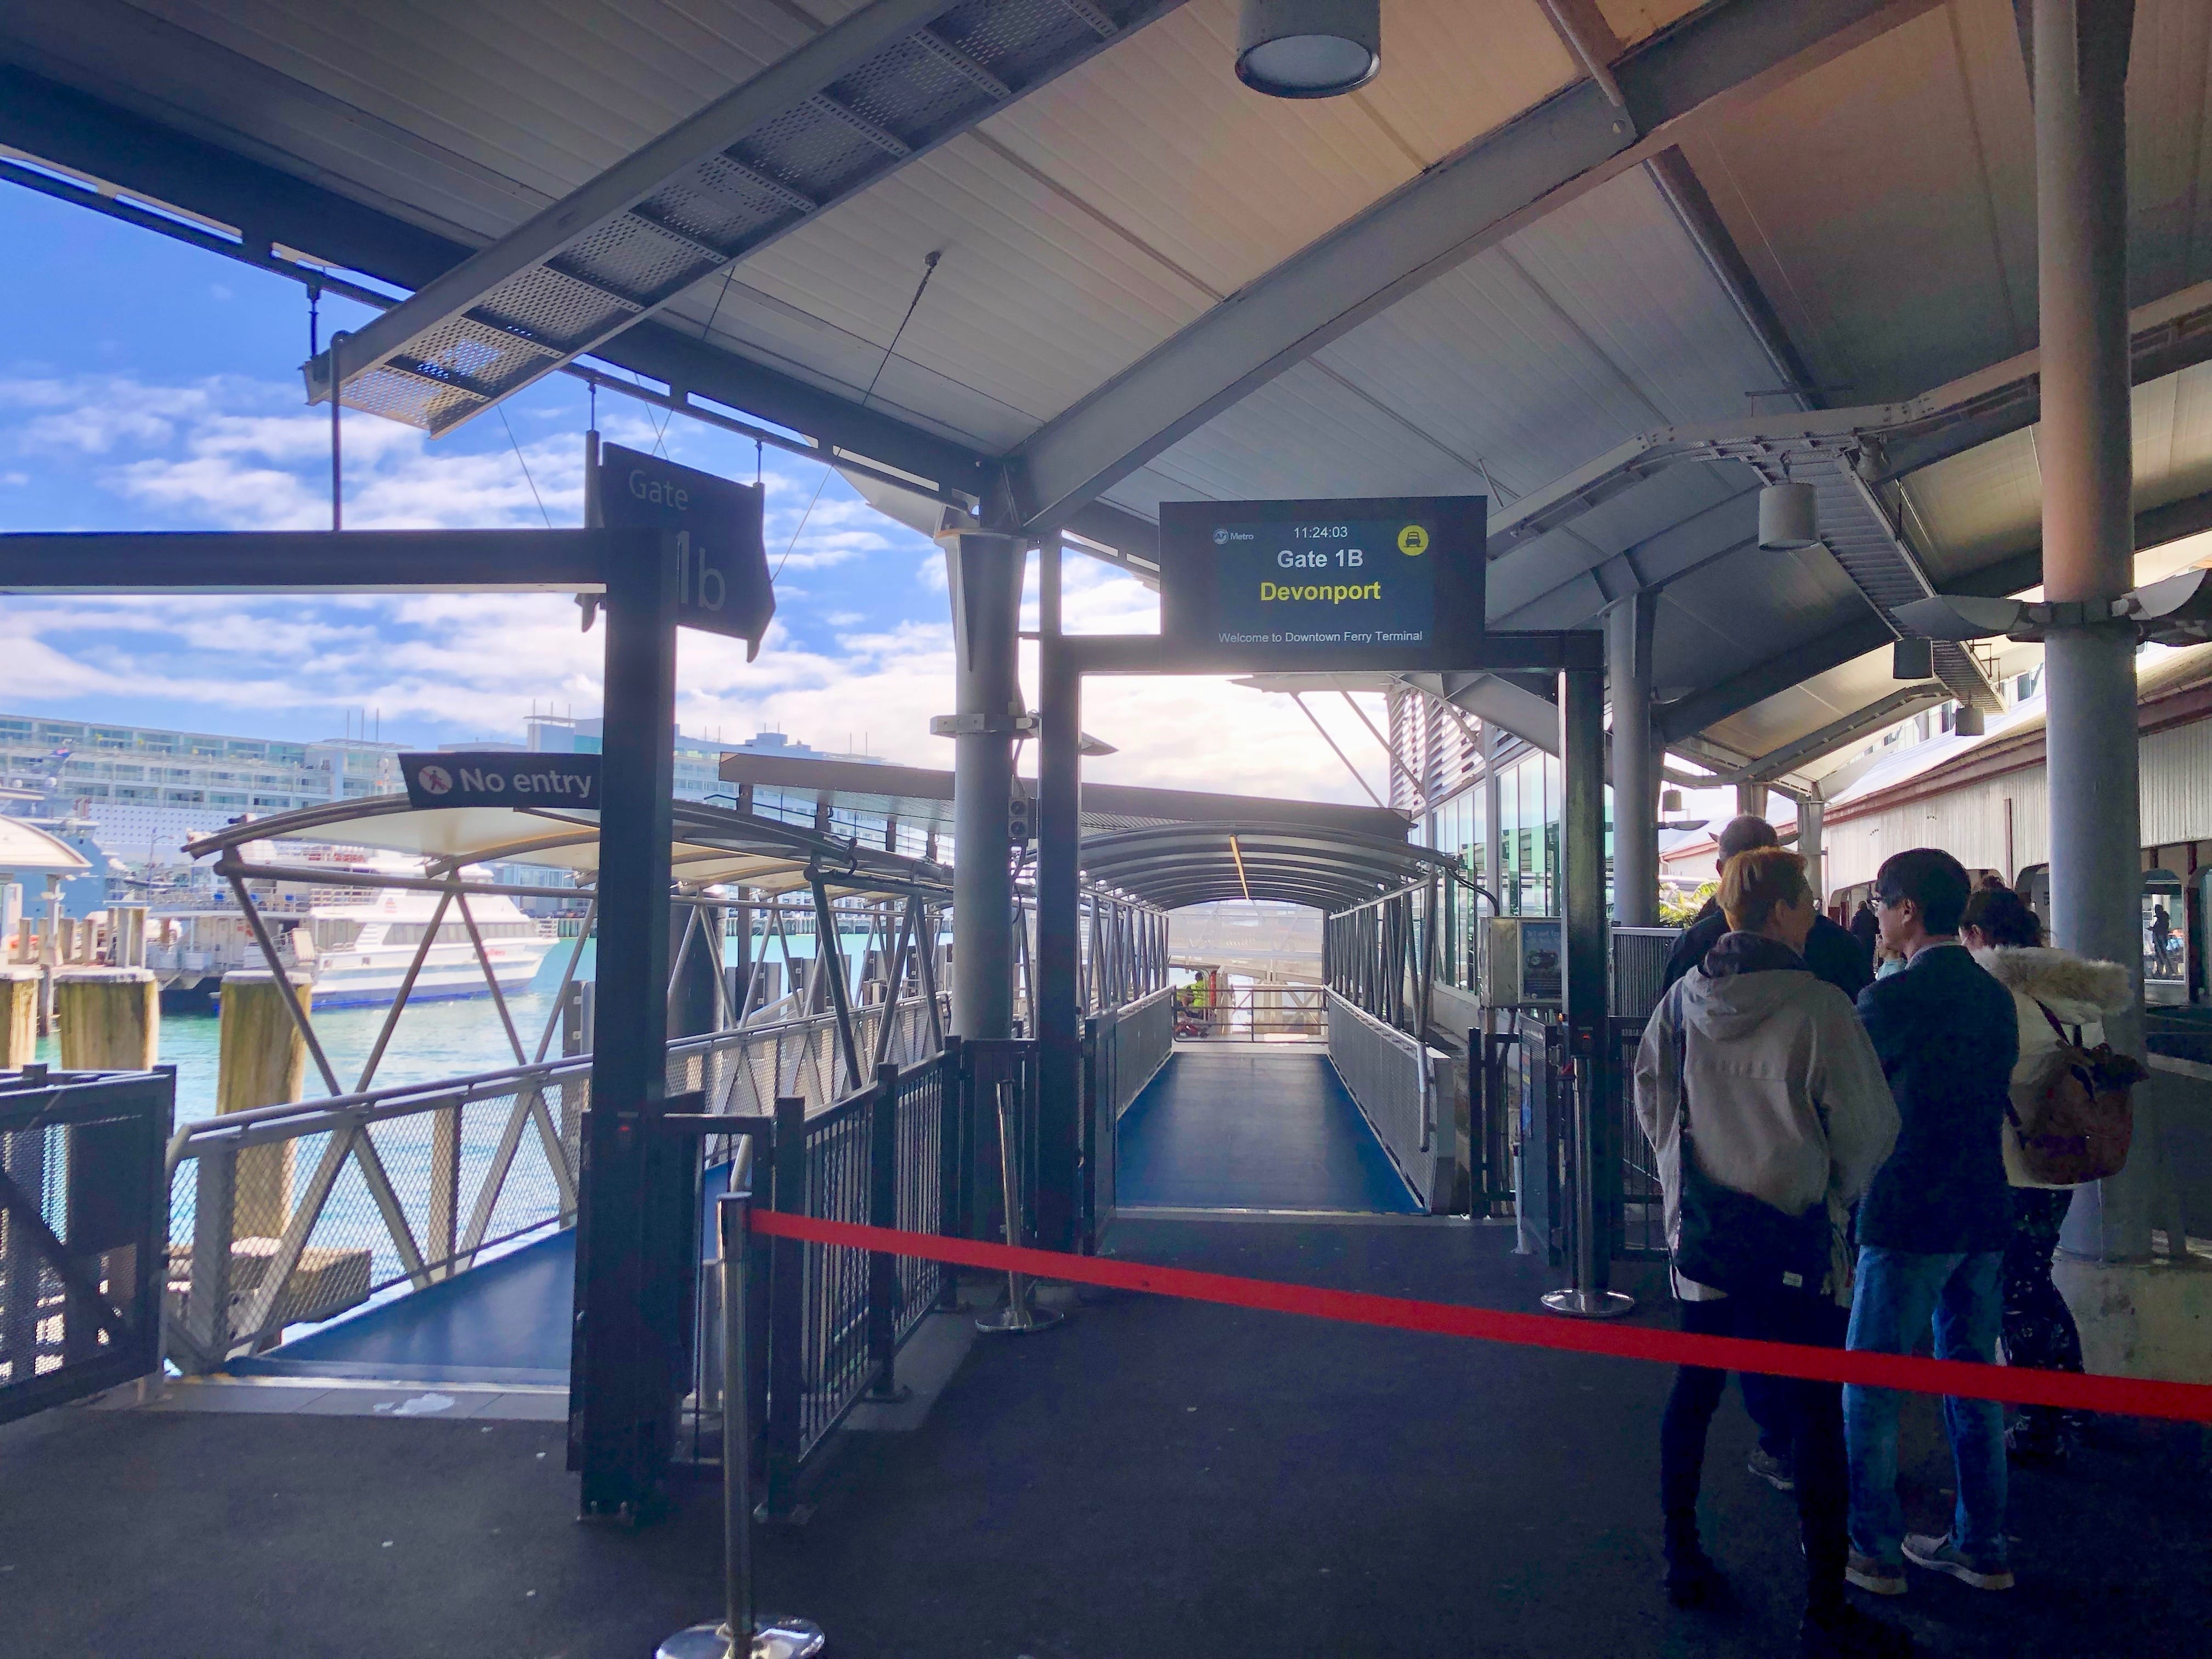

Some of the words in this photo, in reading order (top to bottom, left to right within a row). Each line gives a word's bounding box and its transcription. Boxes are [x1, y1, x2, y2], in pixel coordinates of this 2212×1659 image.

[629, 470, 689, 511] Gate
[1294, 526, 1348, 539] 11:24:03
[1277, 550, 1328, 568] Gate
[1336, 549, 1363, 567] 1B
[676, 530, 725, 611] 1b
[1261, 582, 1381, 604] Devonport
[1218, 633, 1269, 643] Welcome
[1272, 633, 1282, 642] to
[1285, 632, 1340, 642] Downtown
[1344, 631, 1372, 644] Ferry
[1375, 631, 1423, 642] Terminal
[460, 768, 505, 792] No
[514, 770, 592, 798] entry
